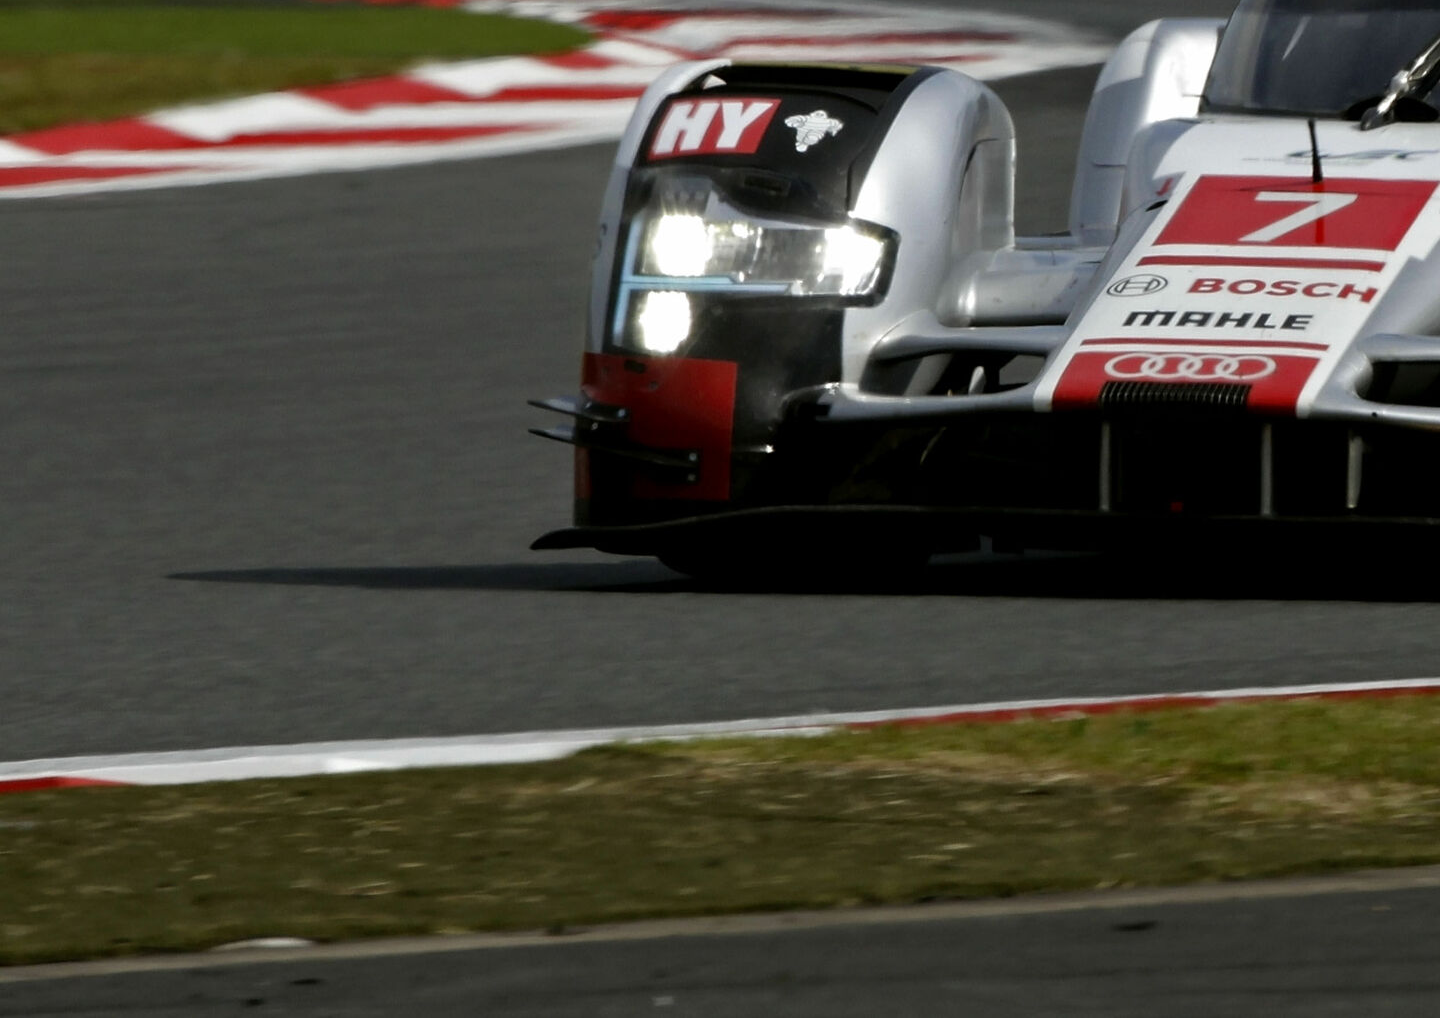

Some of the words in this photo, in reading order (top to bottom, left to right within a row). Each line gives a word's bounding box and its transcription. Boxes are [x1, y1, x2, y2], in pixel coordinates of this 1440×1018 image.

[653, 101, 773, 156] HY
[1238, 191, 1359, 242] 7
[1186, 277, 1379, 304] BOSCH
[1122, 310, 1314, 330] MAHLE
